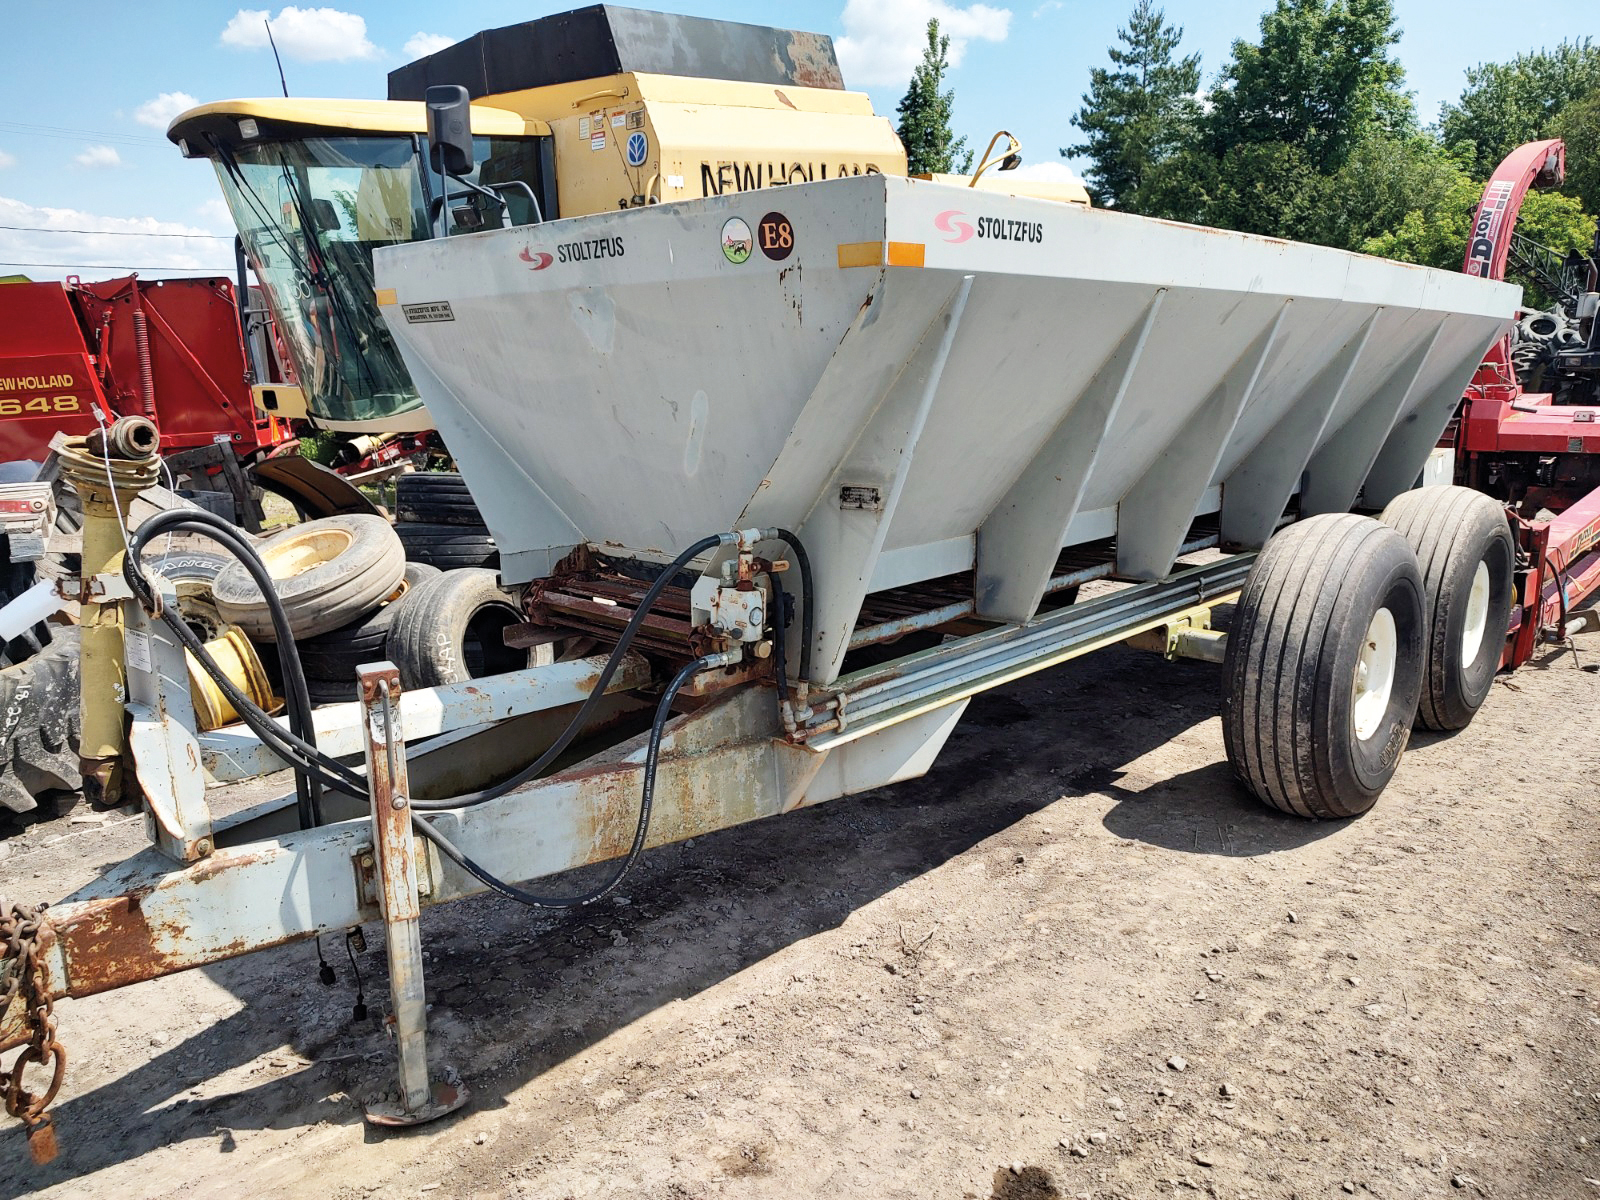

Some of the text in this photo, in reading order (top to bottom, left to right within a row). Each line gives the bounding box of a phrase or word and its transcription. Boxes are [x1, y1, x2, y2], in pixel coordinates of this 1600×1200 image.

[762, 222, 793, 249] E8
[977, 216, 1043, 244] STOLTZFUS
[1471, 209, 1493, 261] DION
[557, 236, 625, 263] STOLTZFUS
[0, 374, 74, 391] EW HOLLAND
[0, 395, 80, 415] 648
